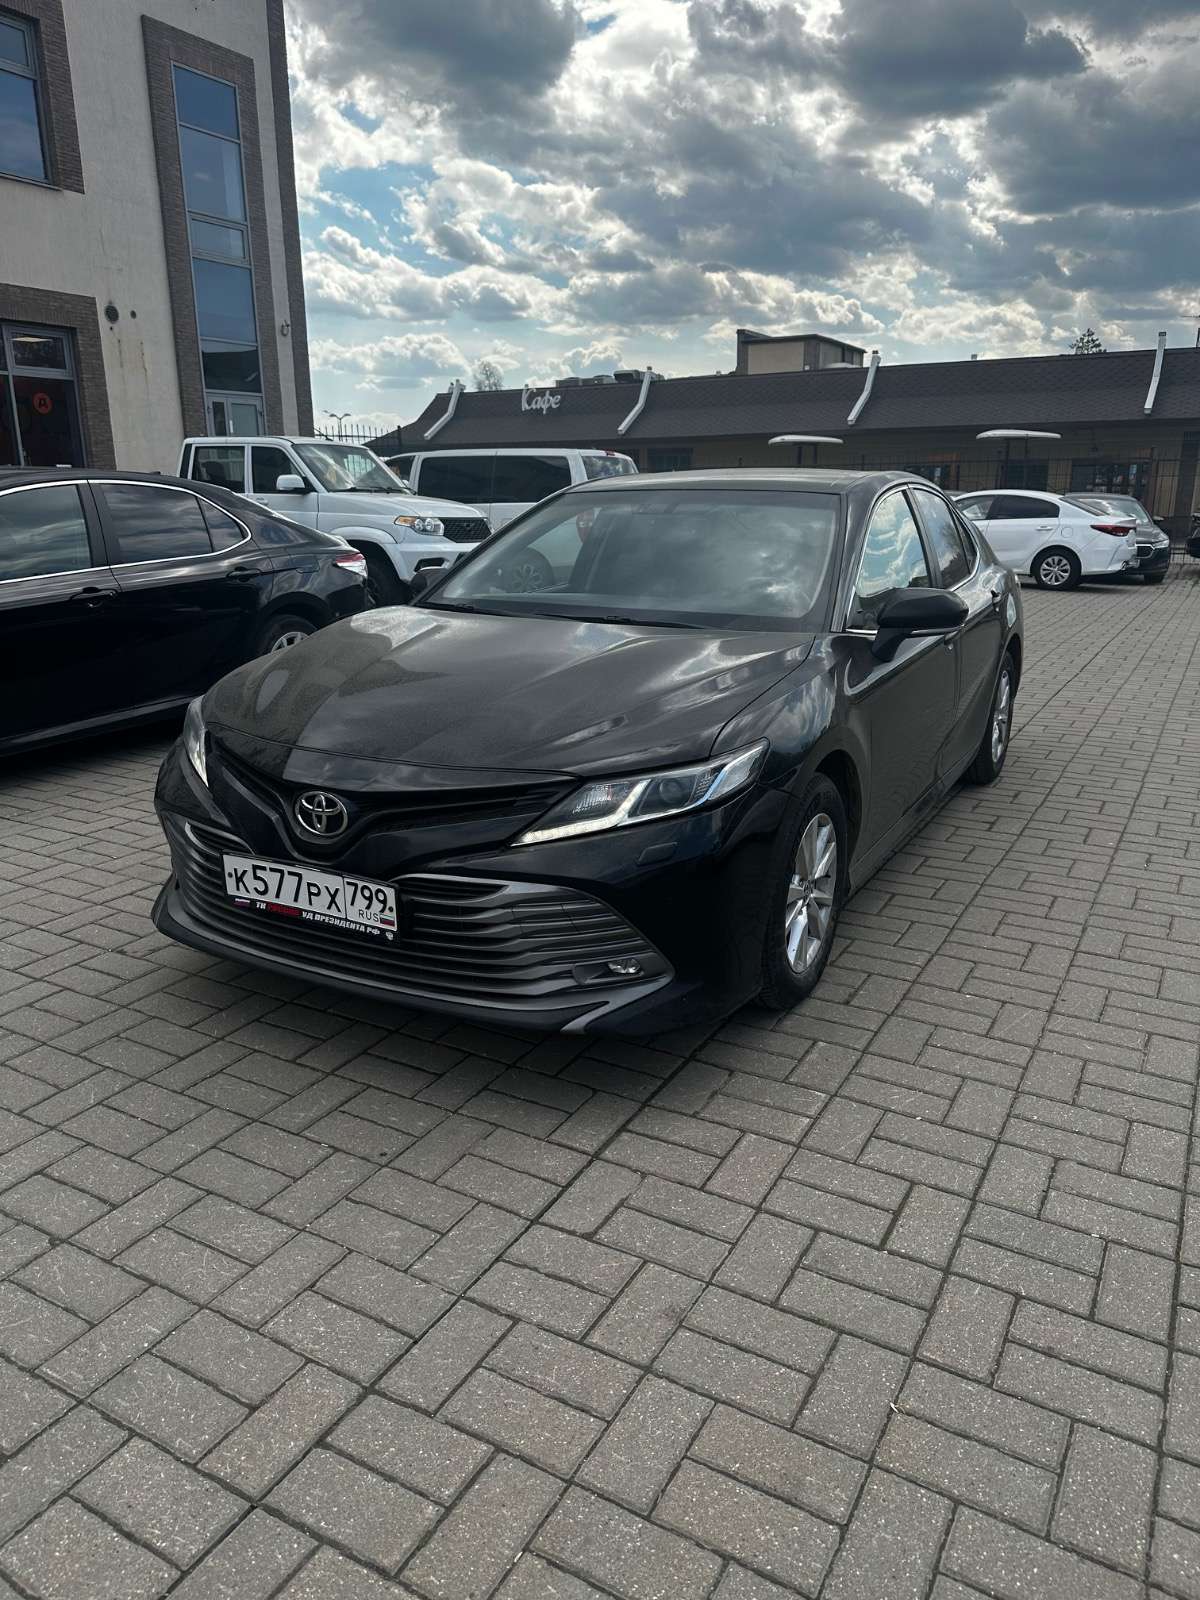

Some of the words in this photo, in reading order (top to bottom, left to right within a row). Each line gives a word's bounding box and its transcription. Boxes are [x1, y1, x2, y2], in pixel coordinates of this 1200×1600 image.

[521, 388, 561, 414] Кафе
[346, 881, 388, 912] 799
[314, 914, 365, 932] ПРЕЗИДЕНТА
[367, 927, 380, 935] РФ
[358, 909, 379, 922] RUS
